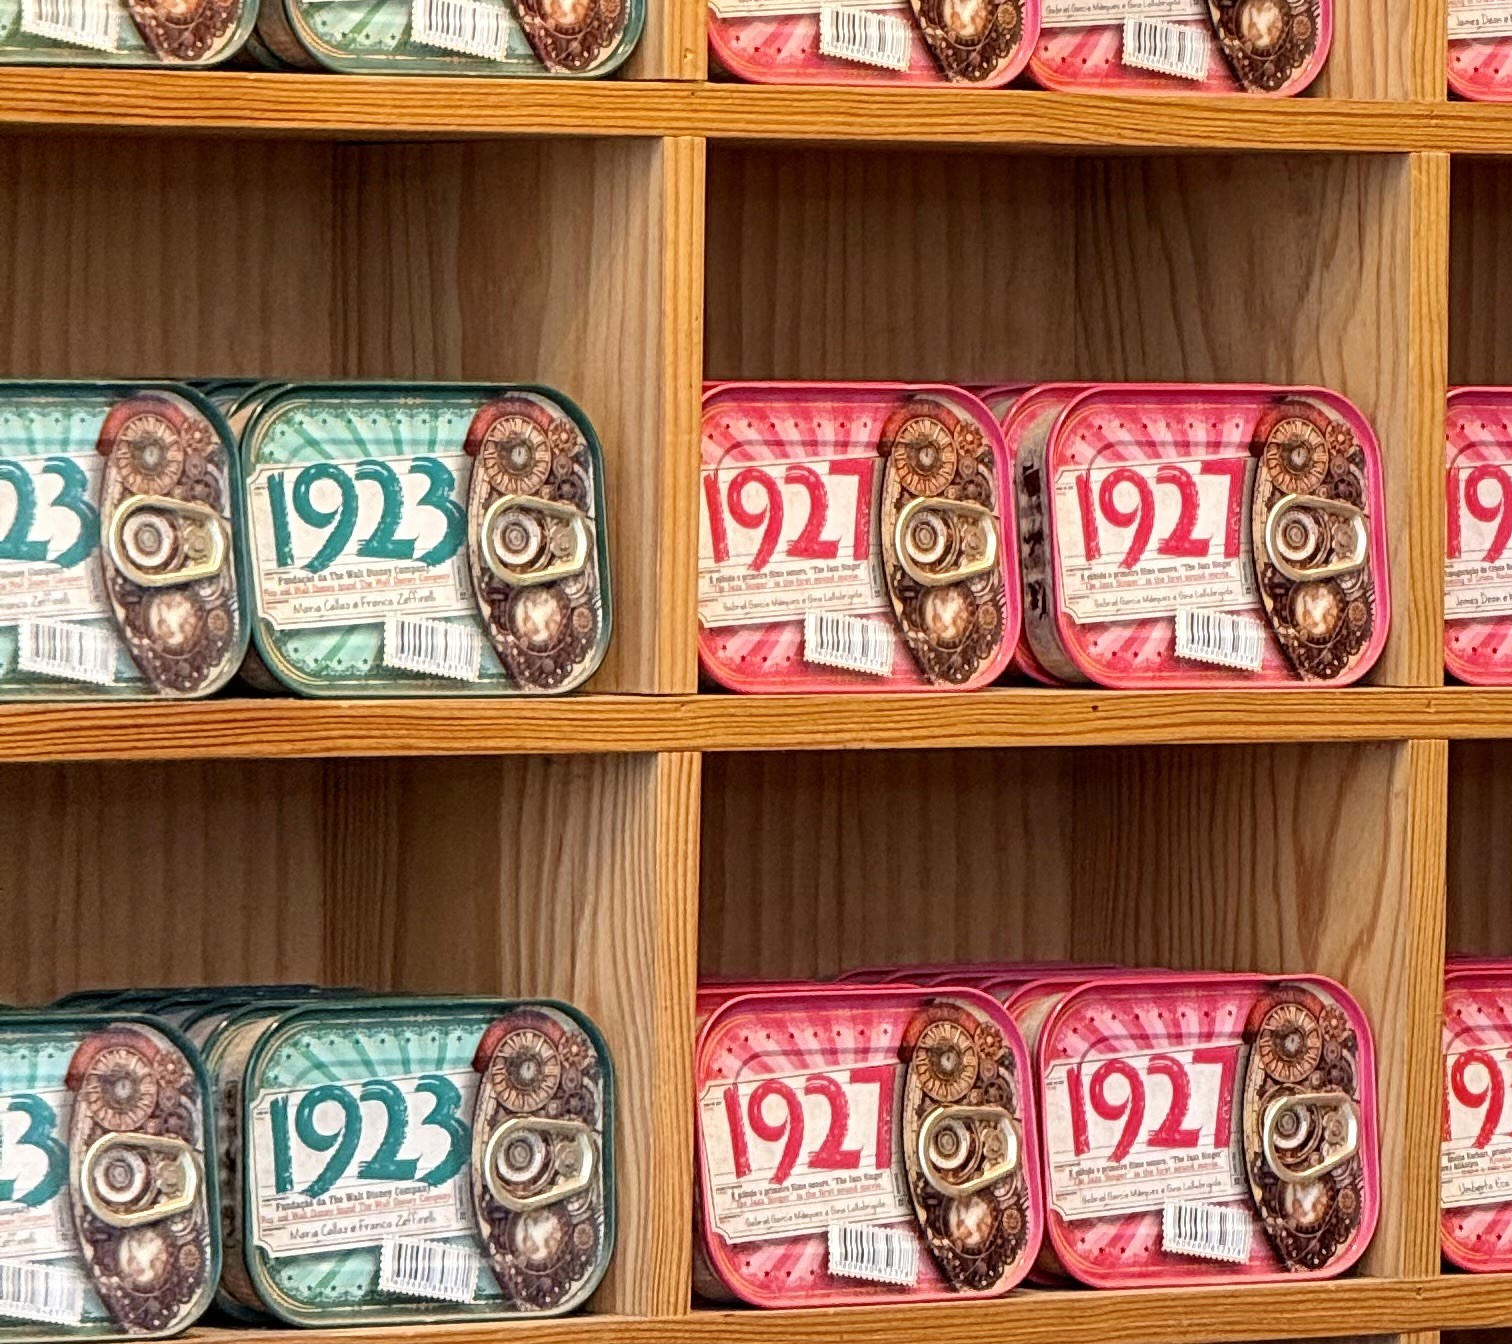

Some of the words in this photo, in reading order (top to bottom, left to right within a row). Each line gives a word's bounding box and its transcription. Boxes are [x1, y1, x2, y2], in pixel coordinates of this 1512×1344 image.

[0, 456, 101, 569] 23
[267, 456, 468, 575] 1923
[705, 459, 877, 574] 1927
[1075, 459, 1247, 574] 1927
[270, 1073, 471, 1197] 1923
[724, 1065, 895, 1186] 1927
[1067, 1046, 1237, 1164] 1927
